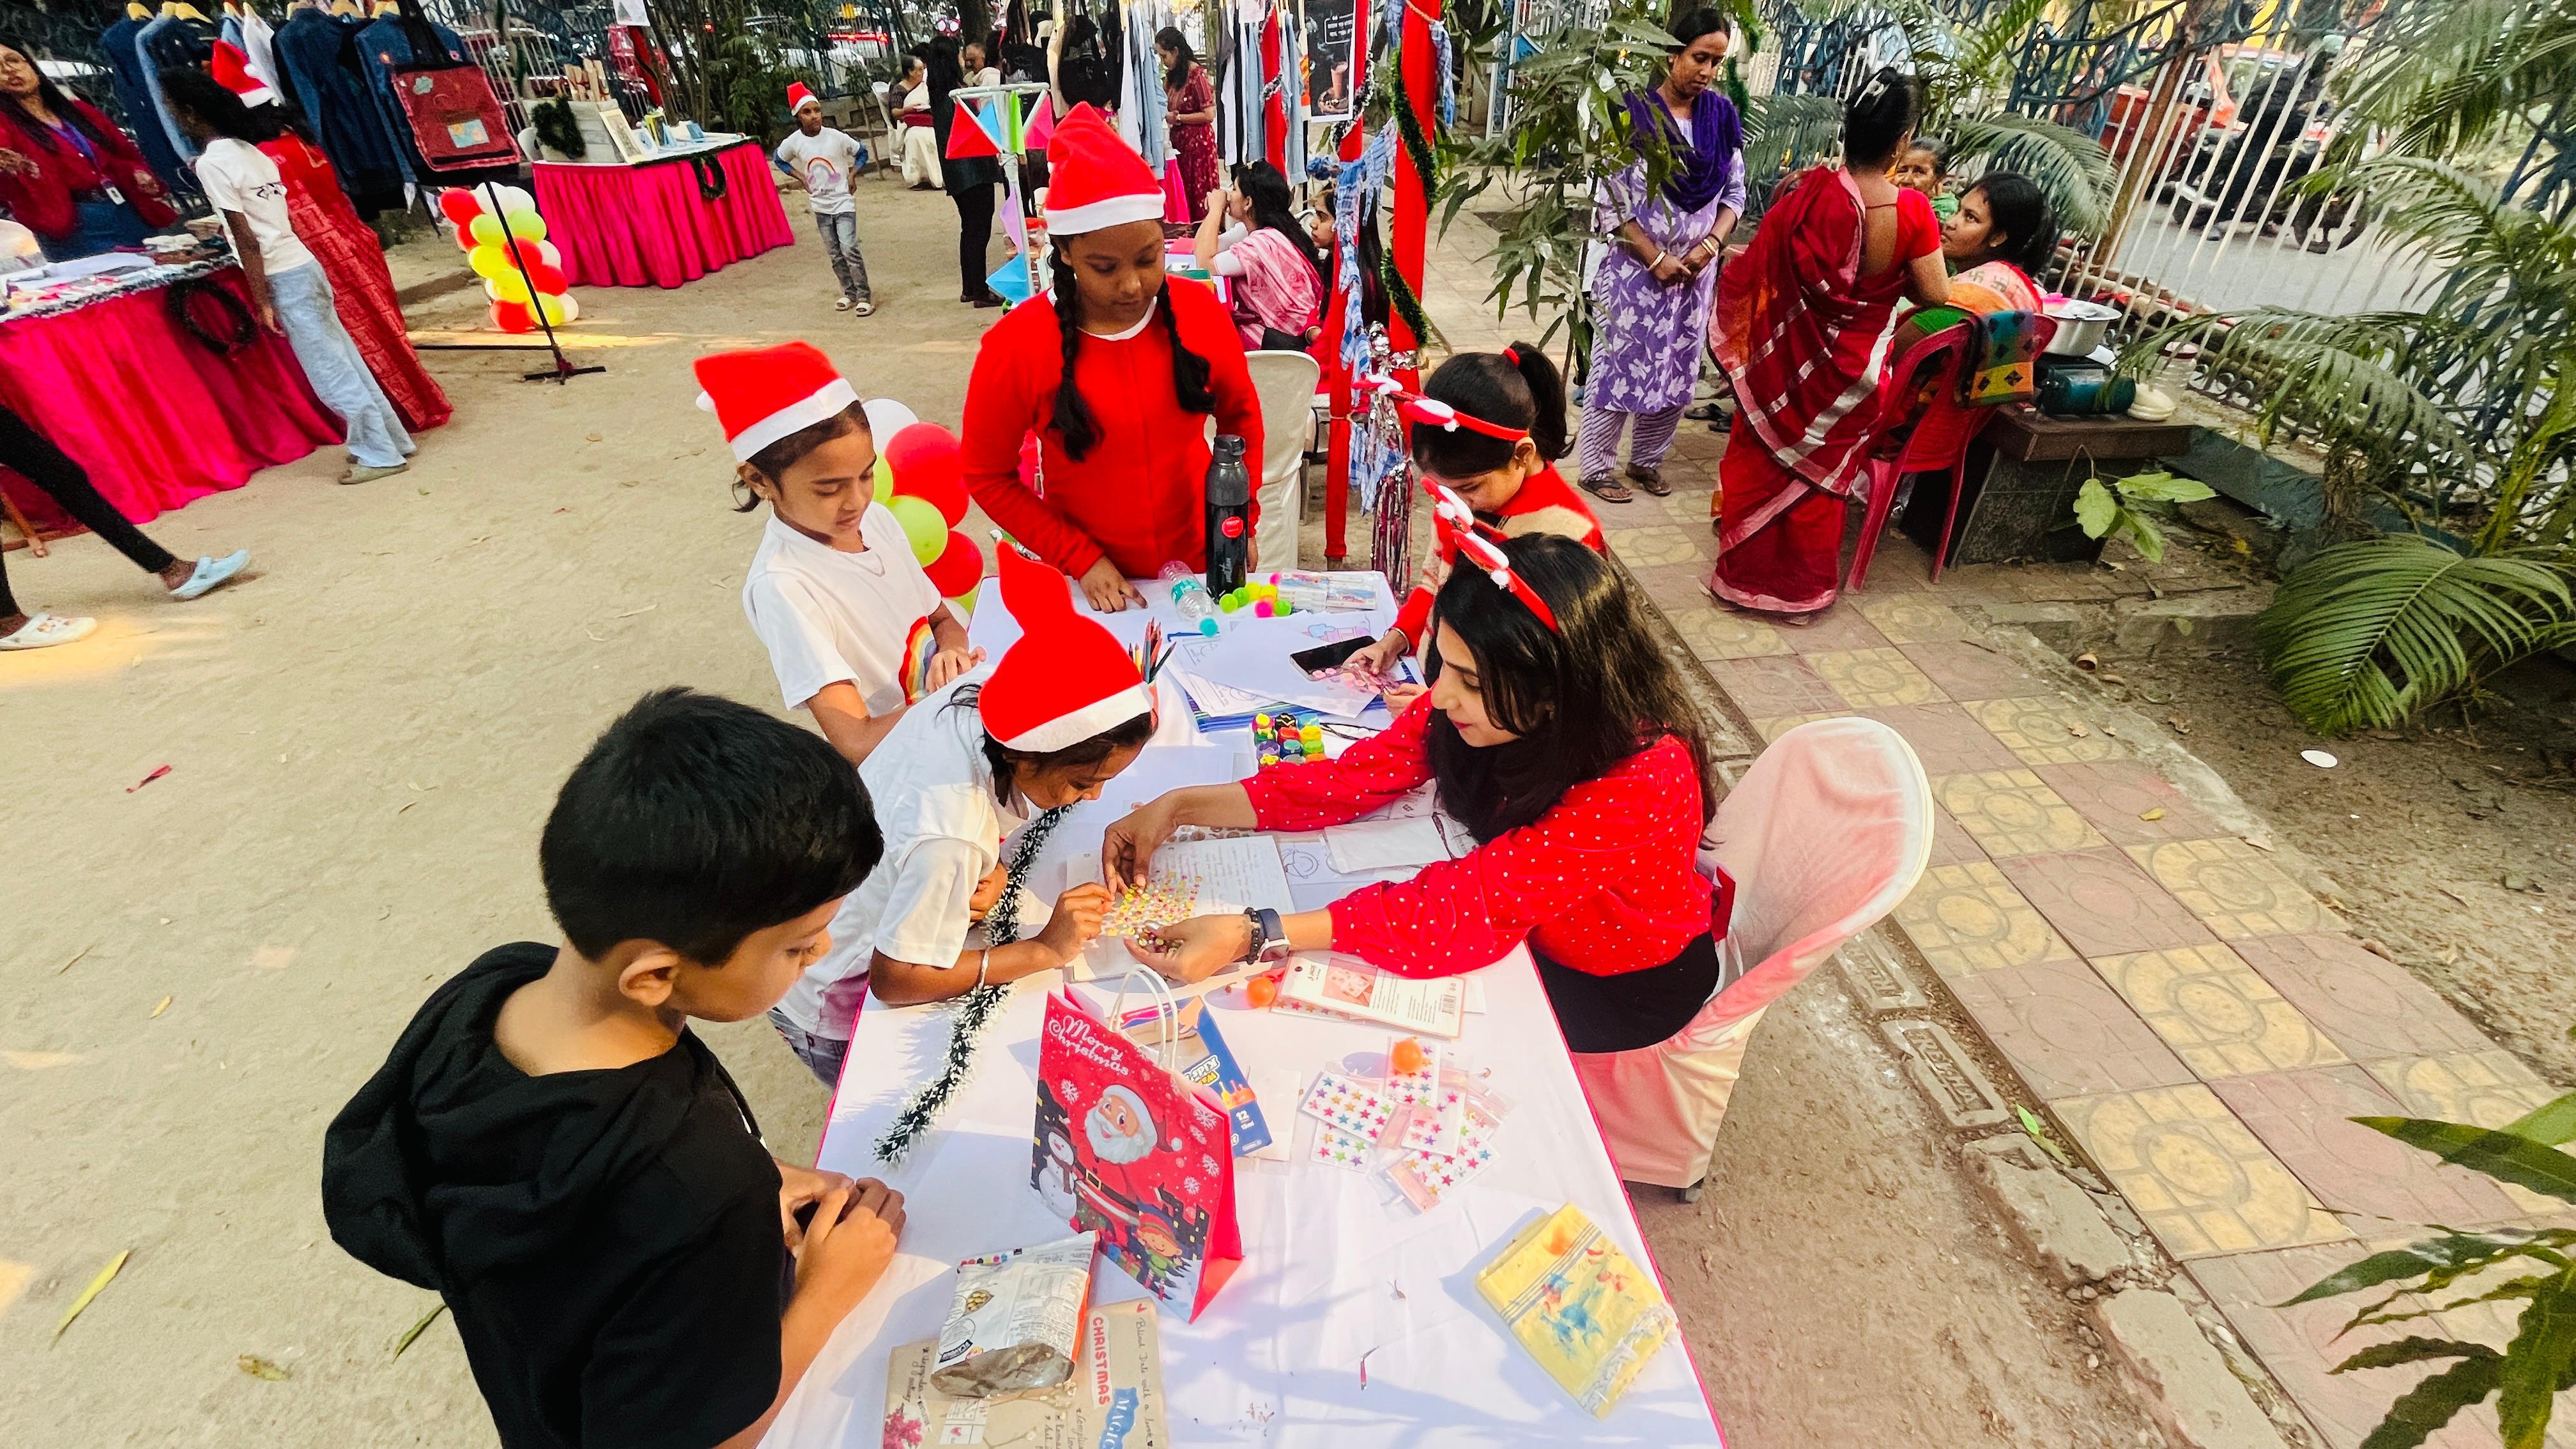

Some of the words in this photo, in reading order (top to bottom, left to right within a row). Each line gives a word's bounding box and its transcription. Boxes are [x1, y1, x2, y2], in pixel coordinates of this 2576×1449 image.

[1048, 1018, 1129, 1076] Christmas
[1062, 1015, 1124, 1062] Merry
[1198, 1071, 1218, 1085] Wa
[1236, 1110, 1250, 1121] 12
[1136, 1317, 1147, 1348] Blind
[1092, 1317, 1111, 1405] CHRISTMAS
[1138, 1354, 1149, 1374] Date
[1141, 1379, 1151, 1398] with
[1103, 1397, 1130, 1449] MAGIC
[1144, 1418, 1154, 1441] book
